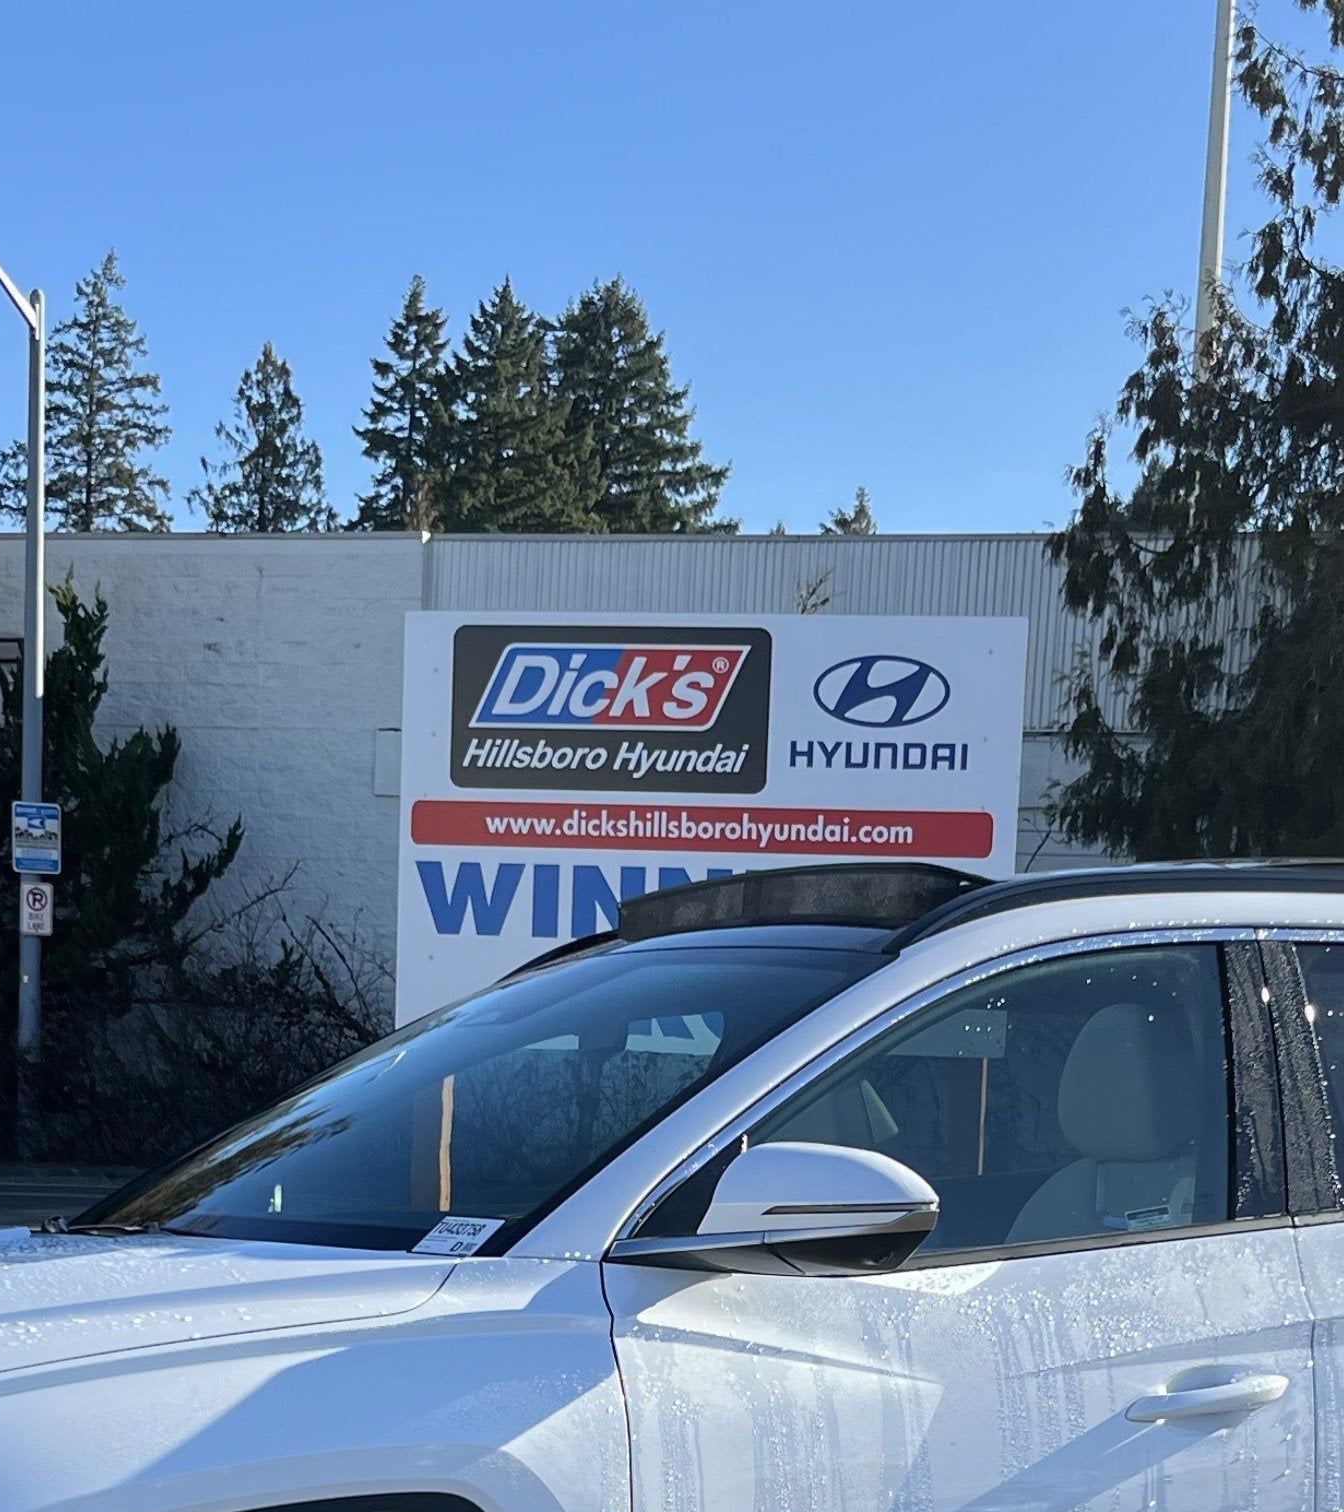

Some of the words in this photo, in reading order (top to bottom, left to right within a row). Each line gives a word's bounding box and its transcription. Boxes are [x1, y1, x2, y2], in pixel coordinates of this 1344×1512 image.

[462, 738, 607, 770] Hillsboro
[613, 741, 749, 778] Hyundai
[789, 741, 968, 771] HYUNDAI
[485, 809, 914, 847] www.dickshillsborohyundai.com
[415, 860, 733, 938] WIN
